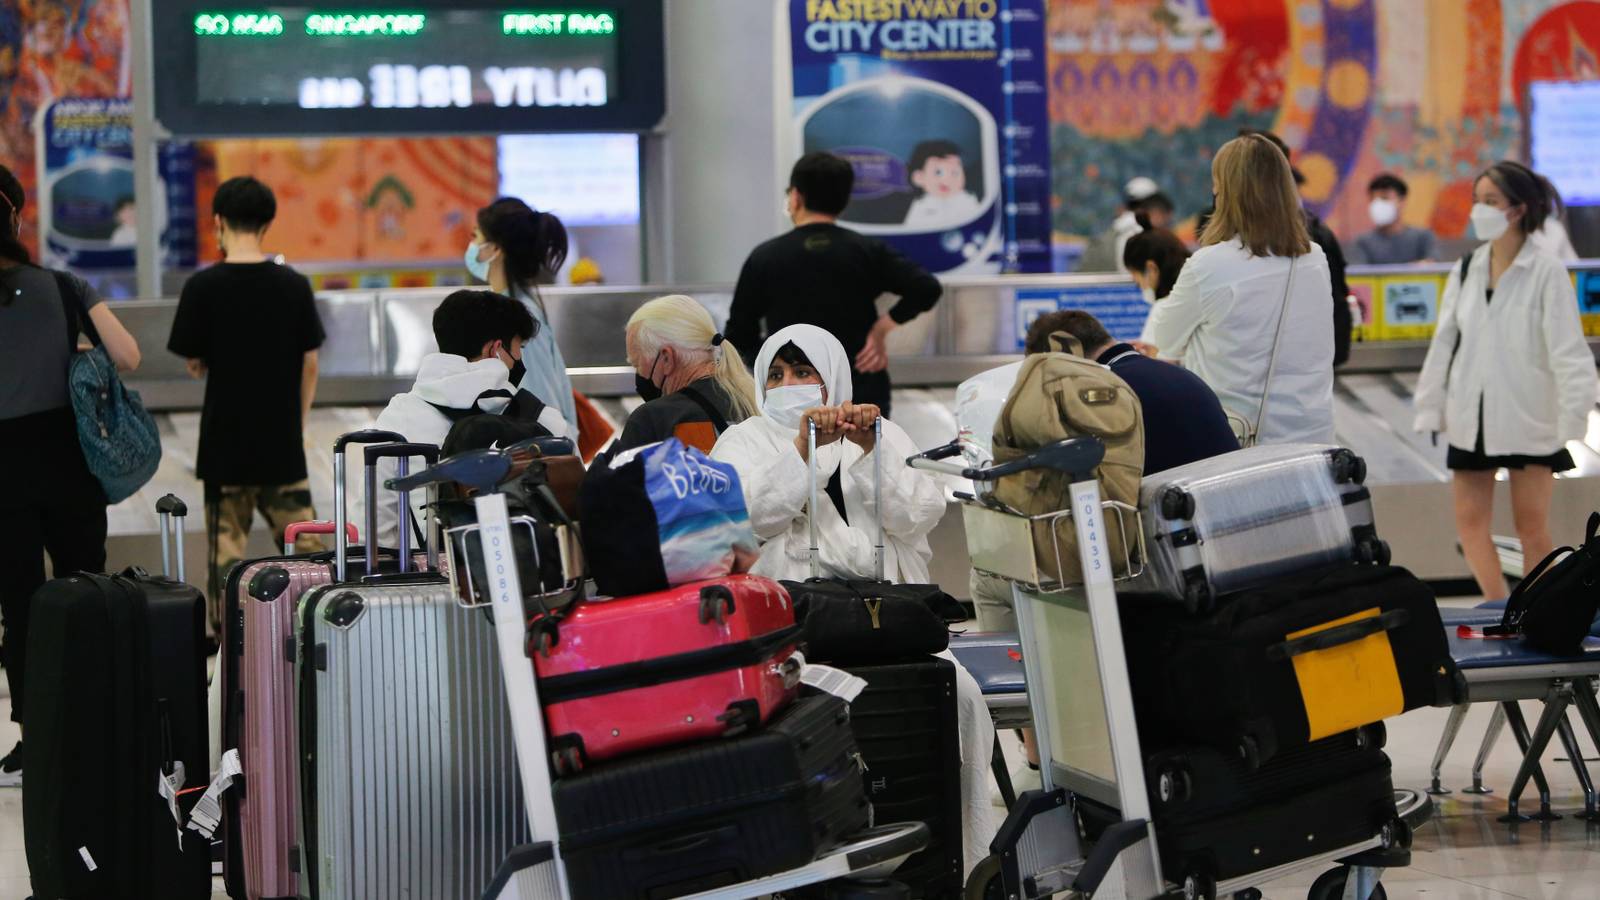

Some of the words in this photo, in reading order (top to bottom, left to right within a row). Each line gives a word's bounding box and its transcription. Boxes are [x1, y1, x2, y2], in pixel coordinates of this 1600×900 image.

[503, 13, 566, 35] FIRST
[806, 0, 903, 21] FASTEST
[906, 0, 962, 19] WAY
[963, 0, 997, 20] TO
[805, 20, 877, 52] CITY
[879, 19, 997, 51] CENTER
[1085, 504, 1101, 570] 04433
[492, 536, 509, 602] 05086
